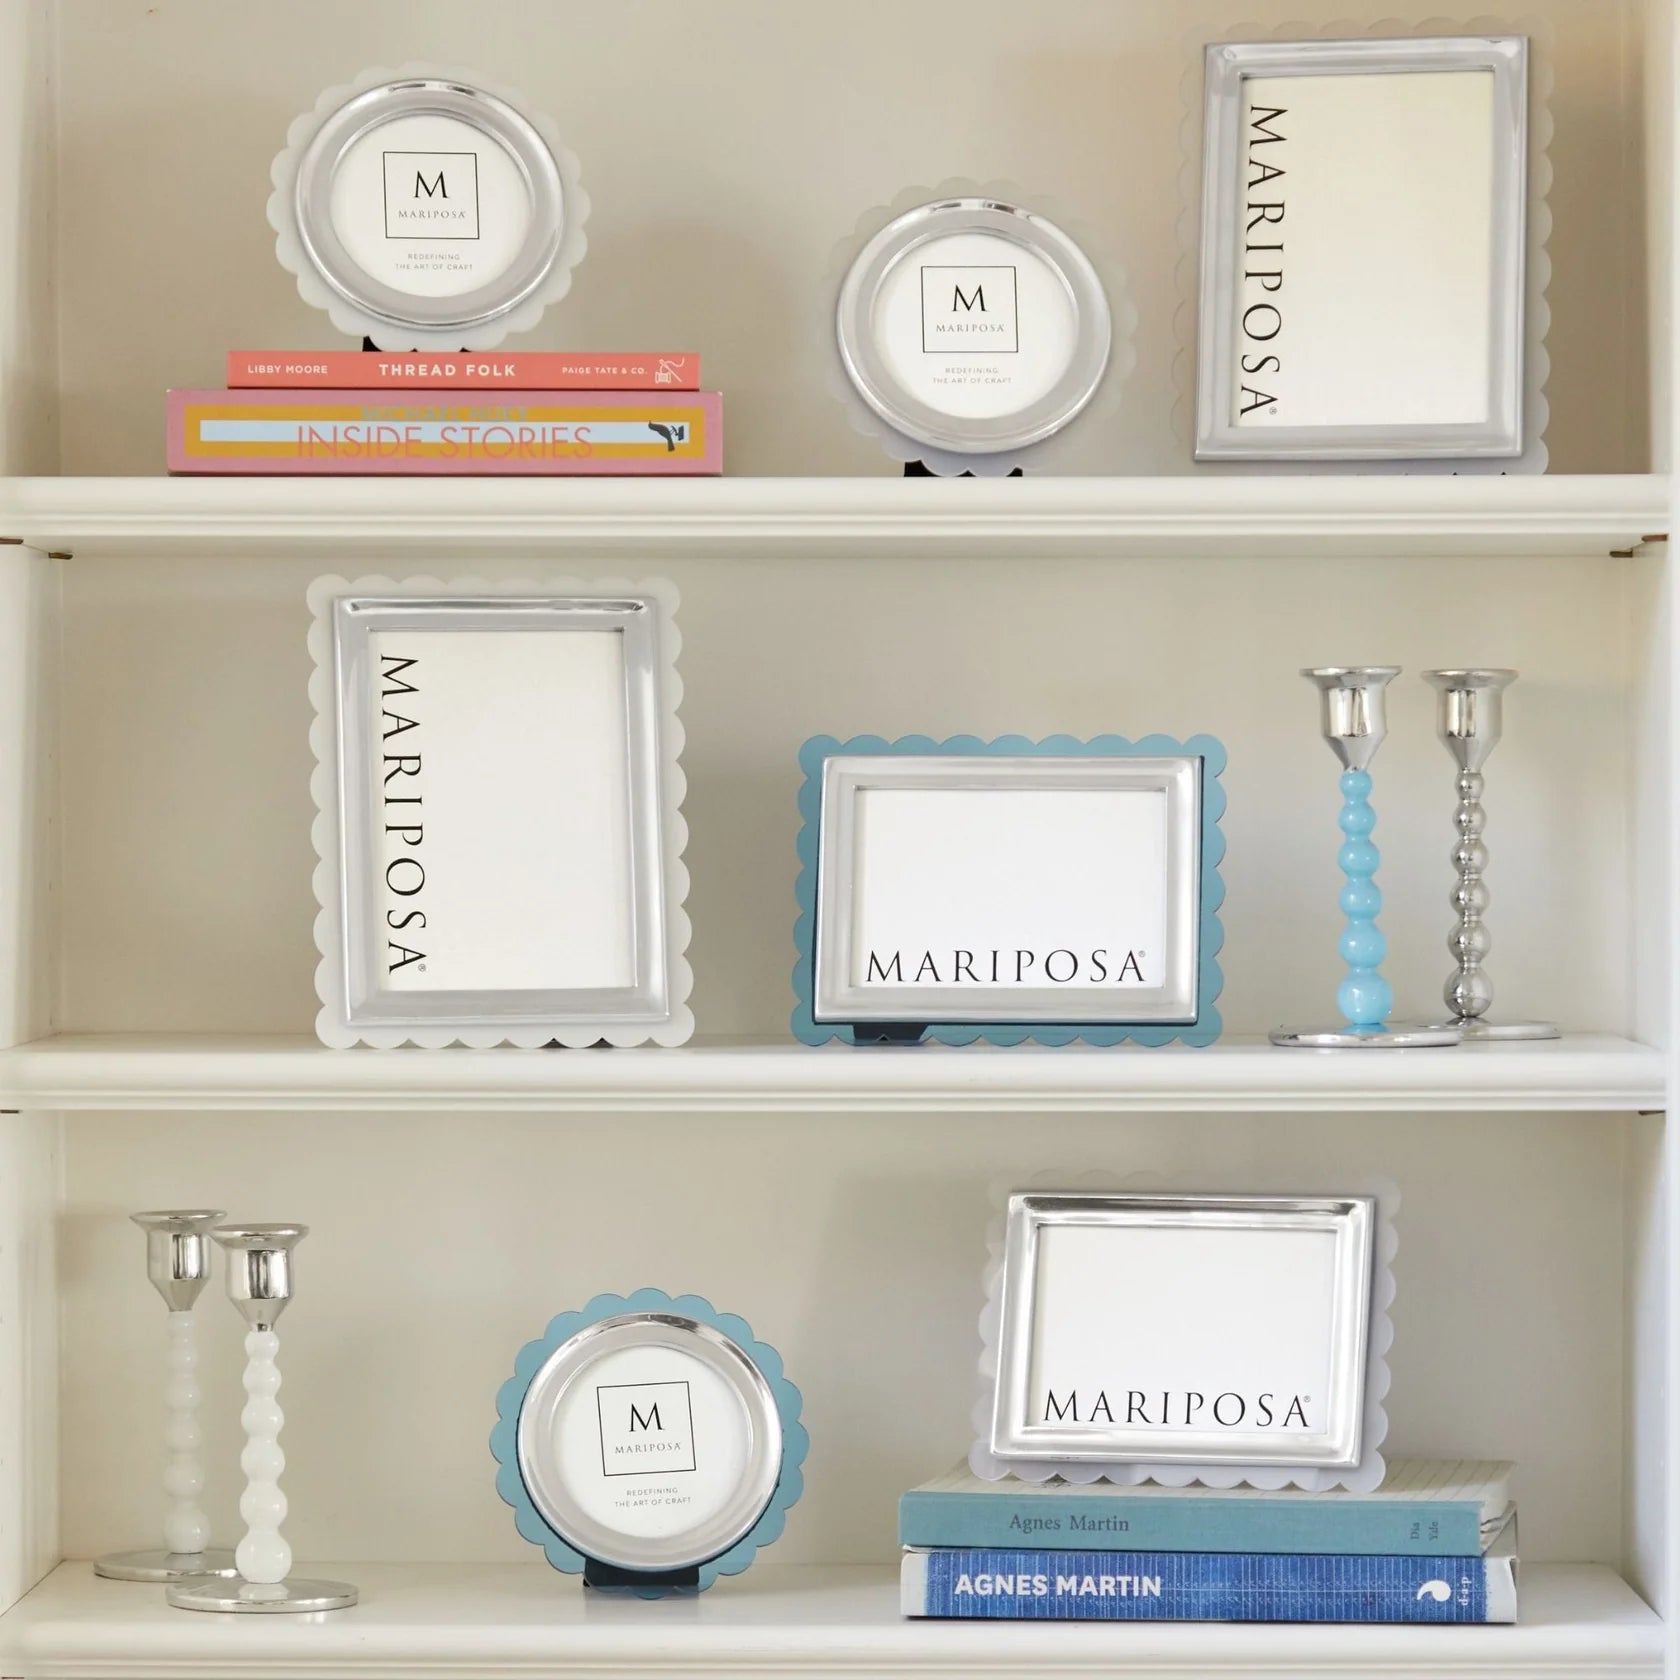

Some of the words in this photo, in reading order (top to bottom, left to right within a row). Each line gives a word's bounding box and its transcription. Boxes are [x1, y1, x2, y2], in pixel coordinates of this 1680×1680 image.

[413, 170, 450, 199] M
[407, 253, 460, 261] REDEFINING
[447, 263, 473, 271] CRAFT
[952, 284, 989, 312] M
[247, 364, 283, 374] LIBBY
[285, 364, 329, 374] MOORE
[379, 363, 457, 377] THREAD
[466, 363, 516, 377] FOLK
[562, 366, 591, 375] PAIGE
[595, 366, 618, 375] TATE
[621, 366, 627, 375] &
[631, 366, 648, 375] CO.
[297, 425, 423, 459] INSIDE
[440, 425, 594, 459] STORIES
[629, 1401, 666, 1432] M
[626, 1487, 679, 1496] REDEFINING
[615, 1500, 630, 1508] THE
[633, 1499, 648, 1507] ART
[651, 1498, 662, 1506] OF
[665, 1496, 692, 1505] CRAFT
[1009, 1512, 1062, 1533] Agnes
[1069, 1513, 1130, 1532] Martin
[954, 1573, 1048, 1597] AGNES
[1056, 1574, 1162, 1598] MARTIN
